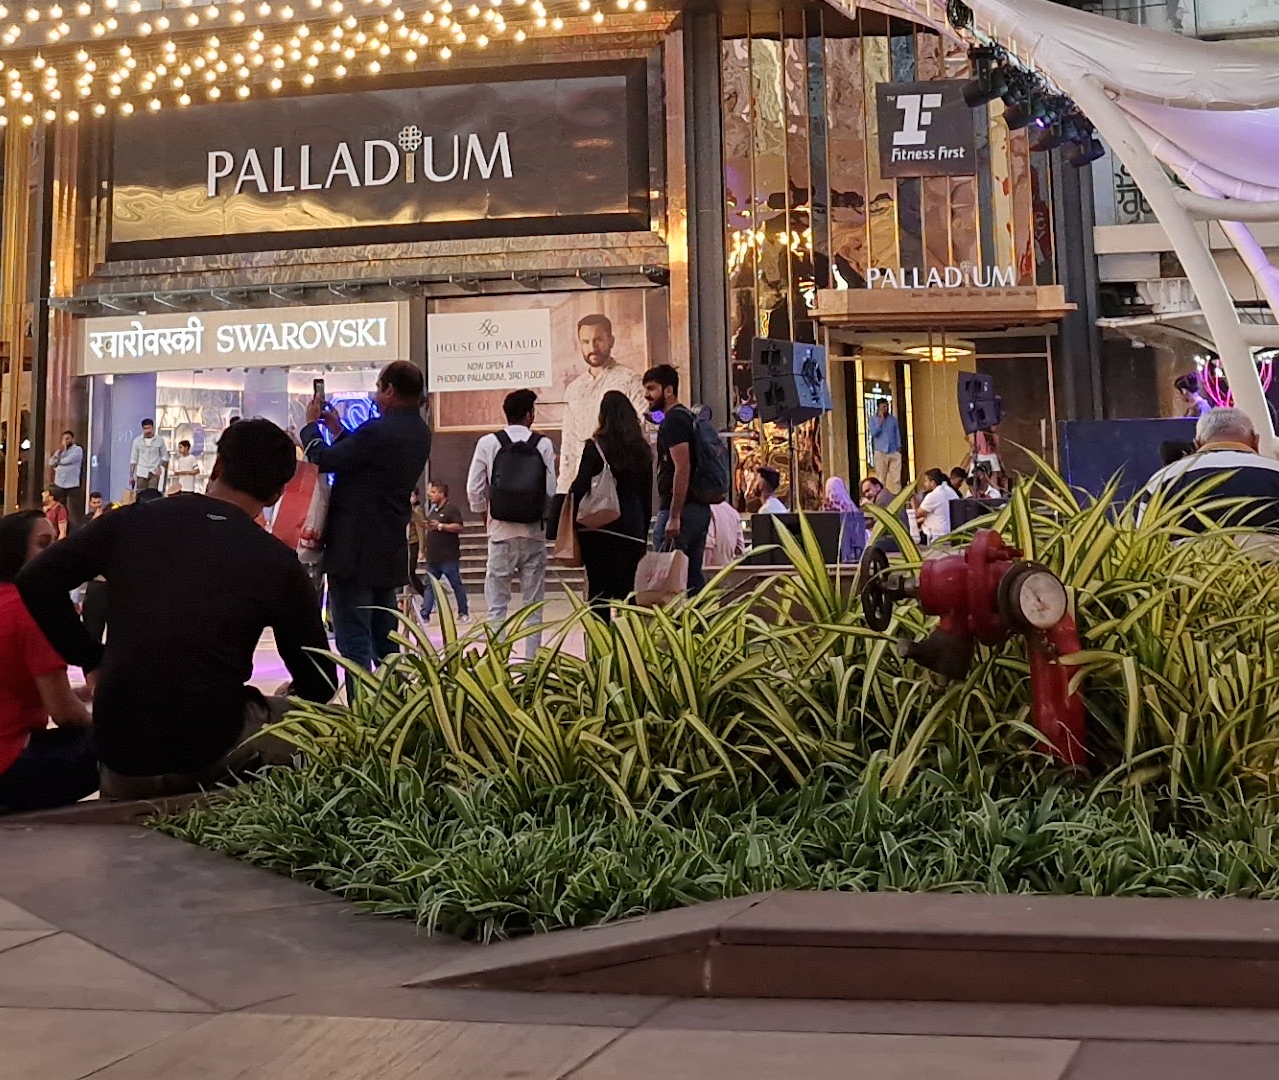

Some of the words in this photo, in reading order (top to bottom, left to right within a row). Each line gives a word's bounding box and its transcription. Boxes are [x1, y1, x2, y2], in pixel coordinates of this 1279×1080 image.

[207, 125, 513, 198] PALLADIUM
[891, 148, 936, 163] Fitness
[938, 146, 966, 161] First
[866, 260, 1016, 290] PALLADIUM
[89, 316, 205, 358] स्वारोवस्की
[216, 317, 387, 353] SWAROVSKI
[436, 342, 475, 353] HOUSE
[477, 340, 492, 351] OF
[495, 339, 542, 351] PATAUDI
[436, 374, 466, 384] PHOENIX
[508, 371, 522, 380] 3RD
[523, 370, 546, 379] FLOOR
[467, 362, 484, 371] NOW
[485, 361, 504, 370] OPEN
[505, 360, 514, 369] AT
